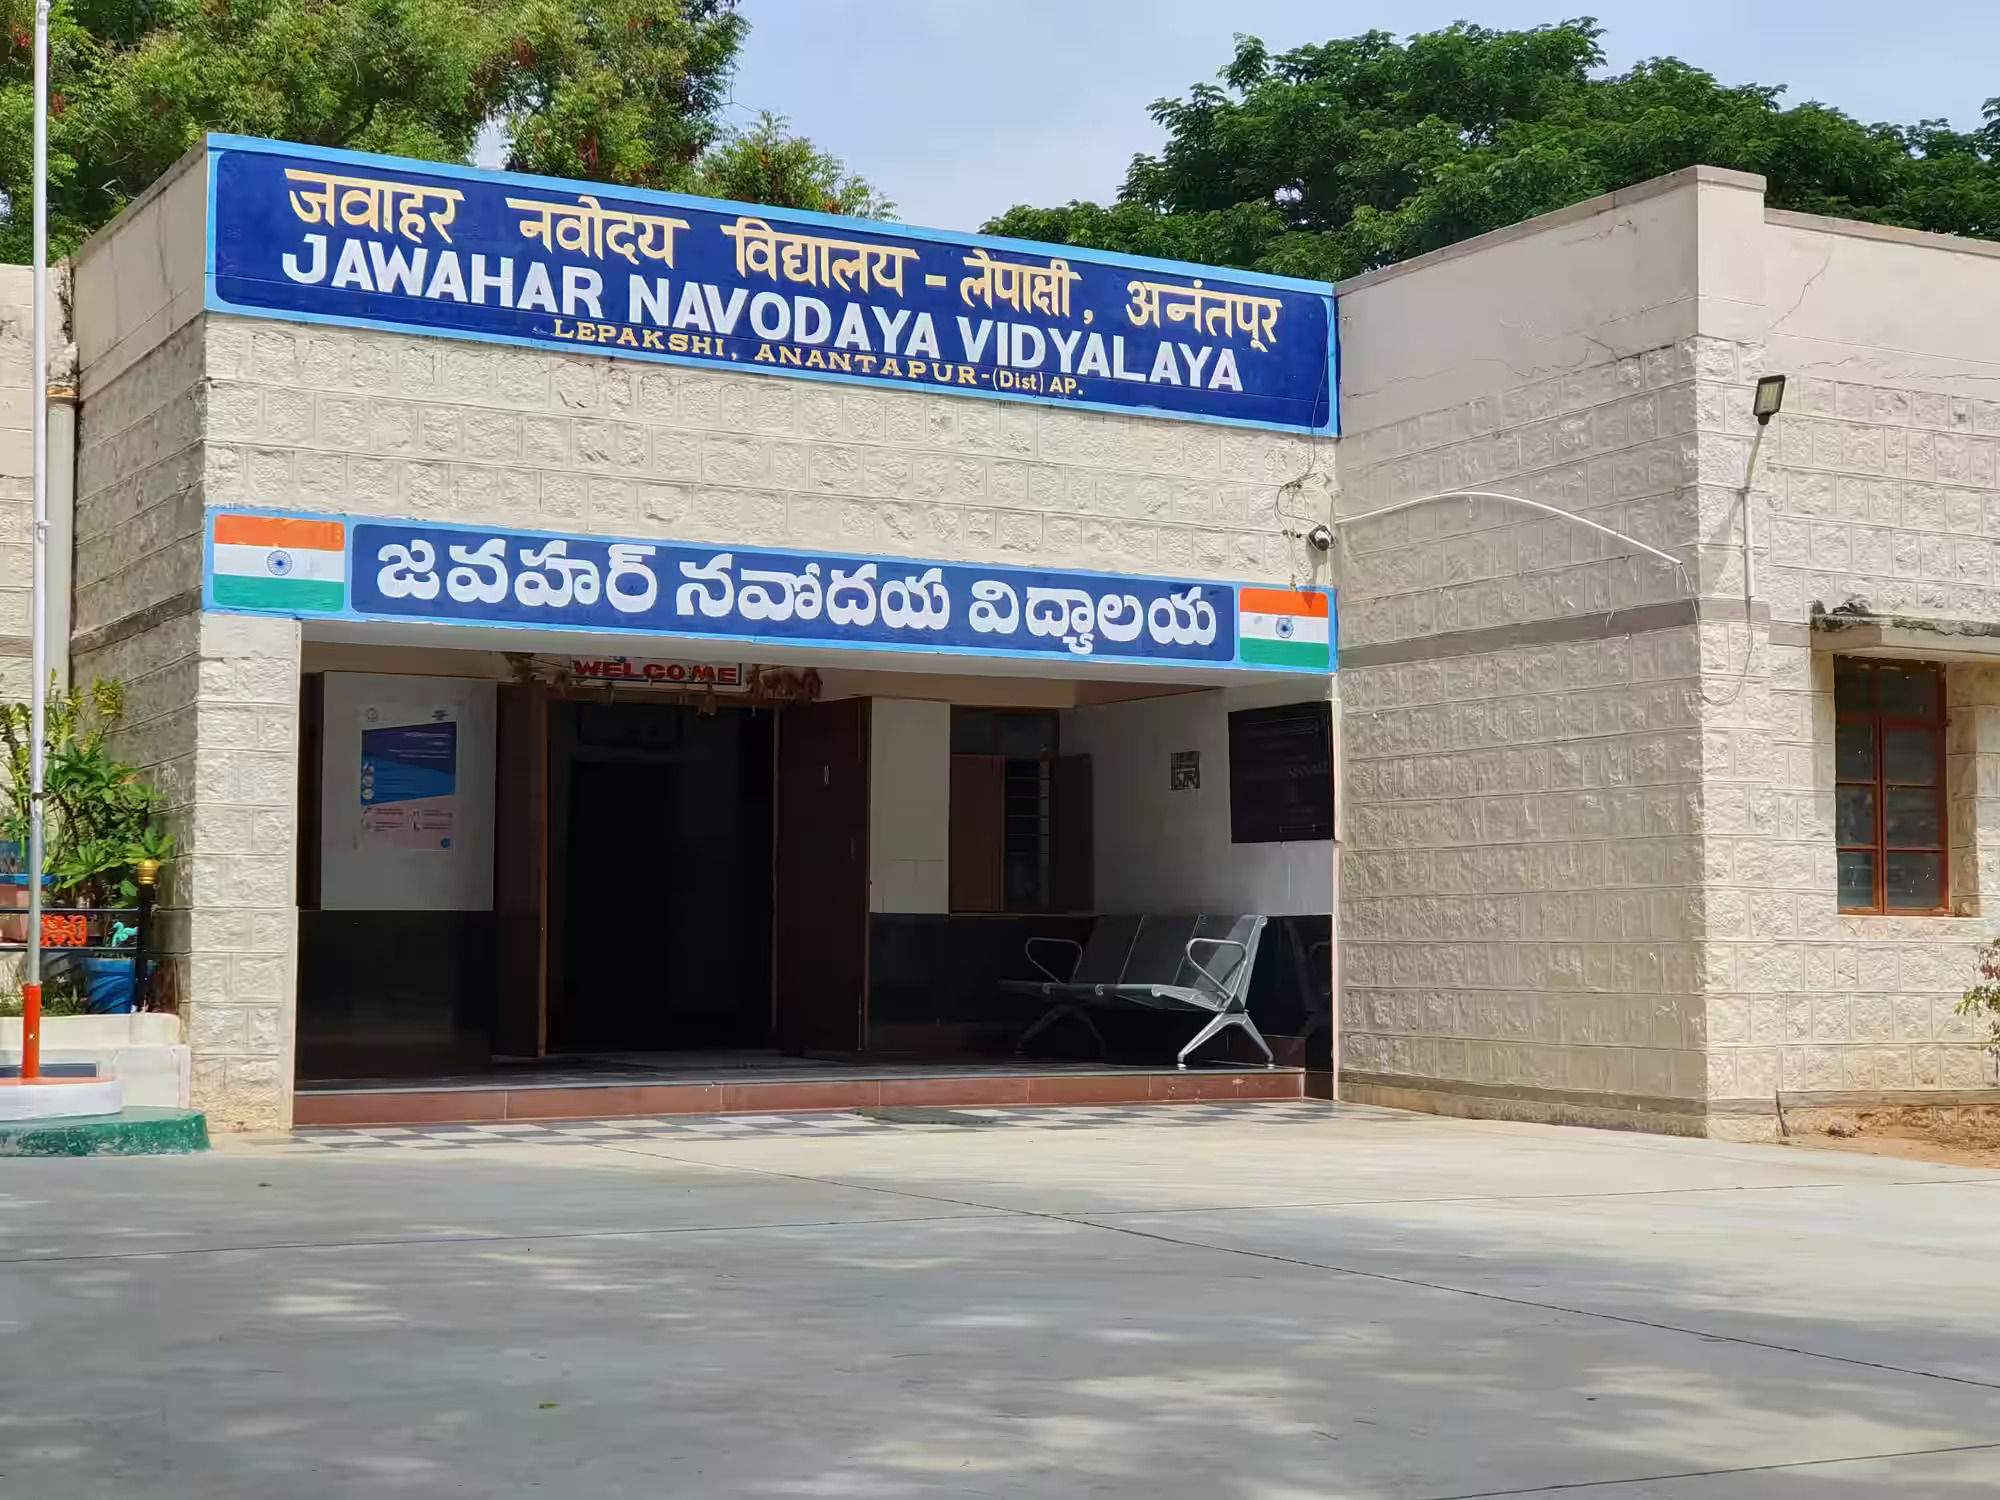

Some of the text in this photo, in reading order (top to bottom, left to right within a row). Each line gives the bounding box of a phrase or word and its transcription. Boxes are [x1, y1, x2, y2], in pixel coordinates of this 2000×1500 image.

[282, 233, 1244, 391] JAWAHAR NAVODAYA VIDYALAYA
[284, 168, 465, 244] जवाहर
[505, 195, 690, 269] नवोदय
[719, 216, 920, 298] विद्यालय
[1126, 279, 1282, 352] अनंतपूर
[553, 319, 738, 361] LEPAKSHI,
[377, 538, 1216, 655] జవహార్ నవోదయ విద్యాలయ
[573, 660, 737, 683] WELCOME
